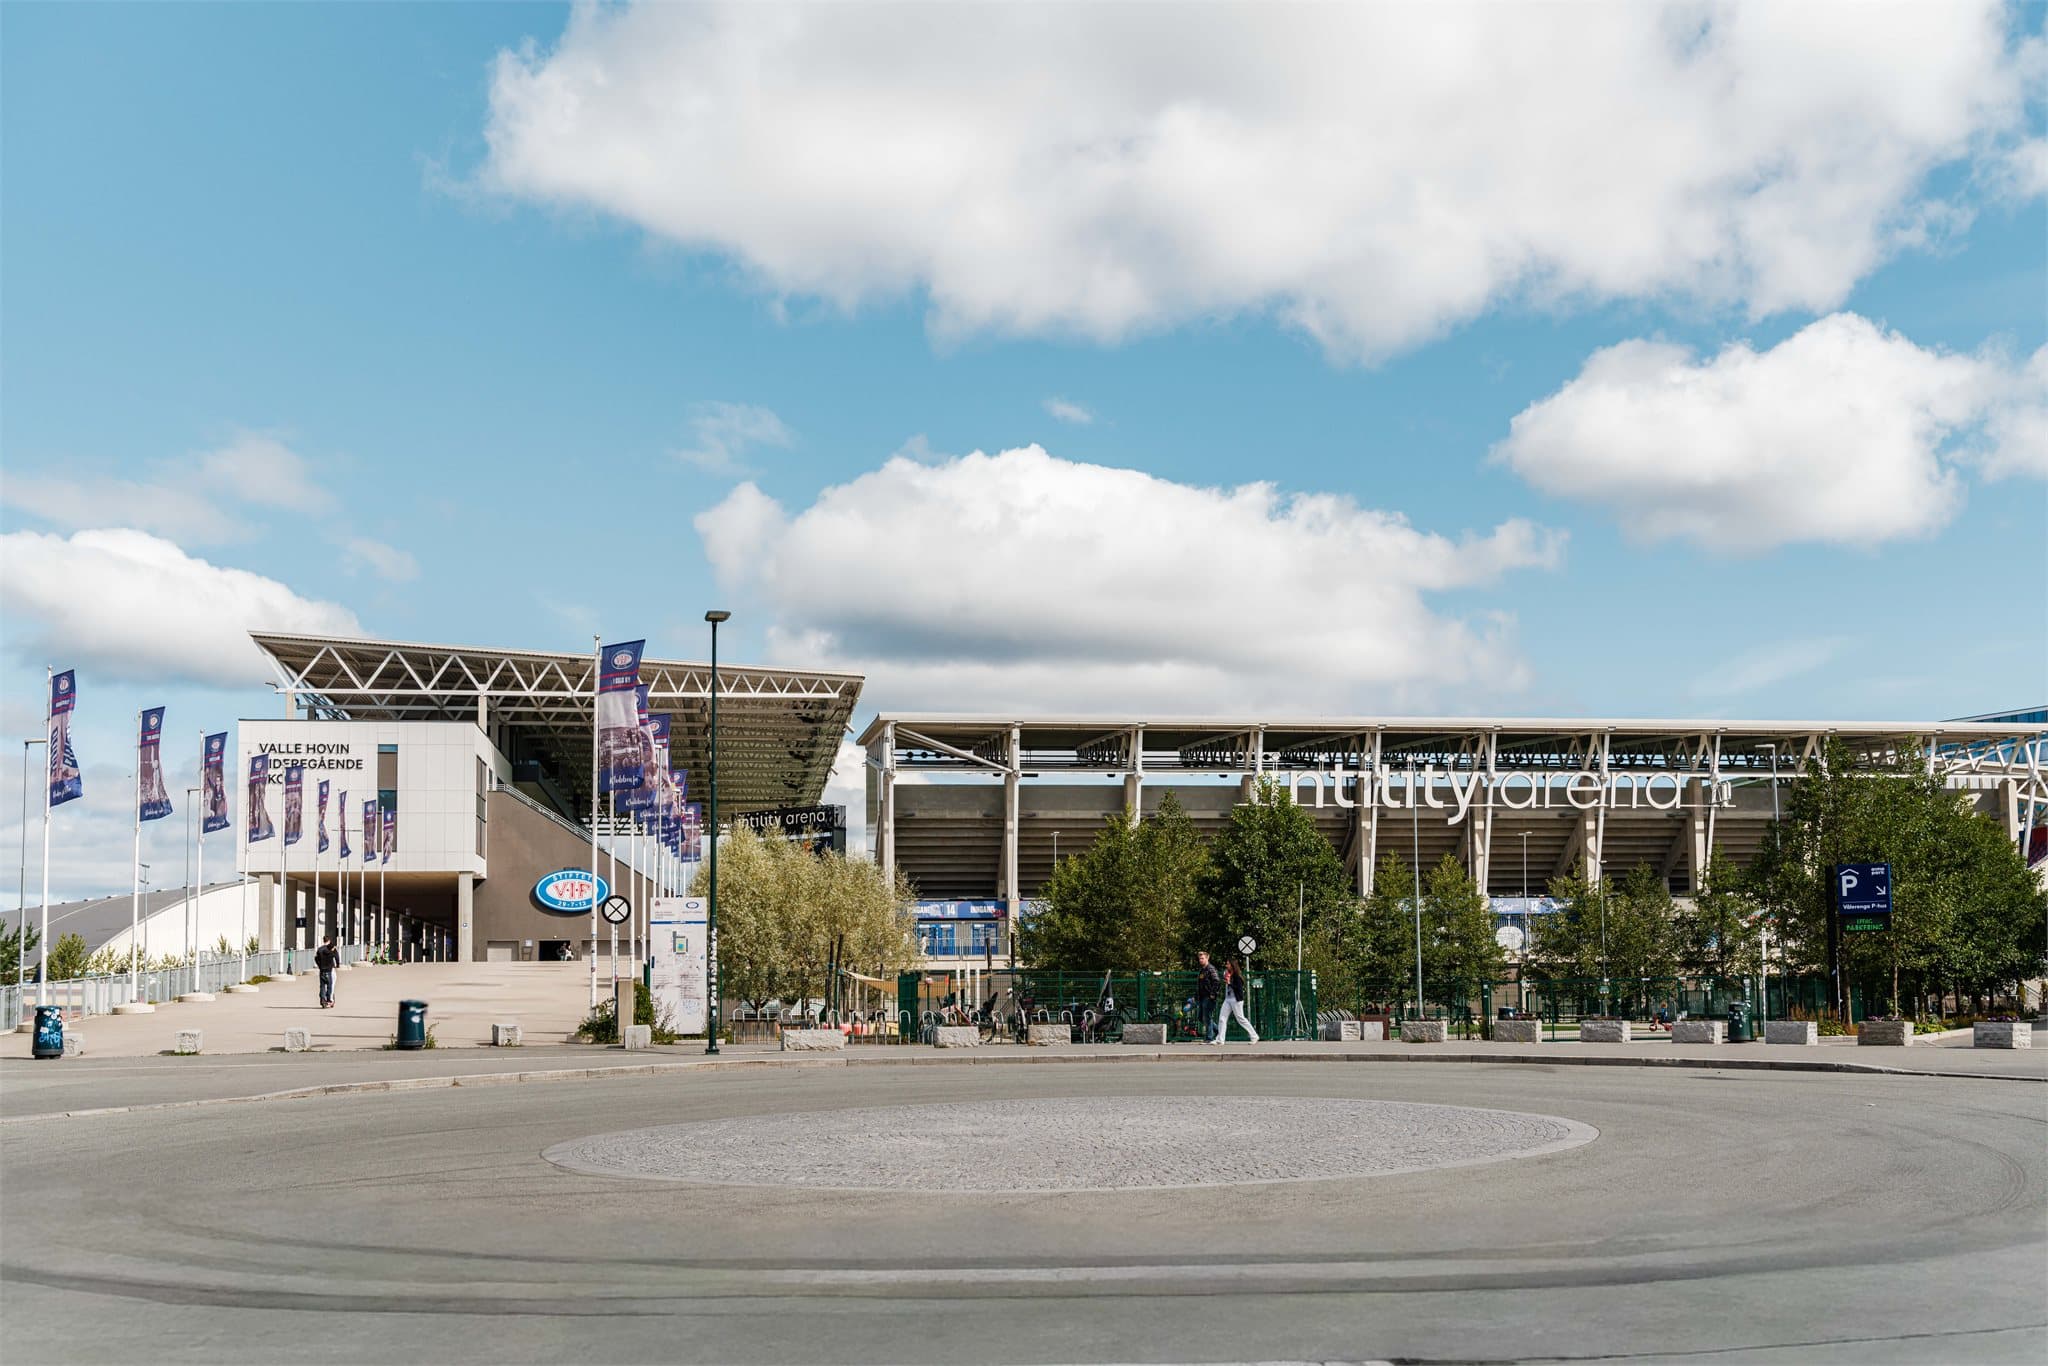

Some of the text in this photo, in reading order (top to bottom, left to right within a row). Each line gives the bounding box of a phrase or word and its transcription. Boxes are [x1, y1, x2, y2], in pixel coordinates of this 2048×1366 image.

[259, 743, 350, 754] VALLE HOVIN
[268, 756, 363, 769] IDEREGÅENDE
[1270, 754, 1681, 826] intility arena
[785, 811, 825, 825] arena
[1841, 875, 1858, 897] P
[945, 903, 956, 914] 14
